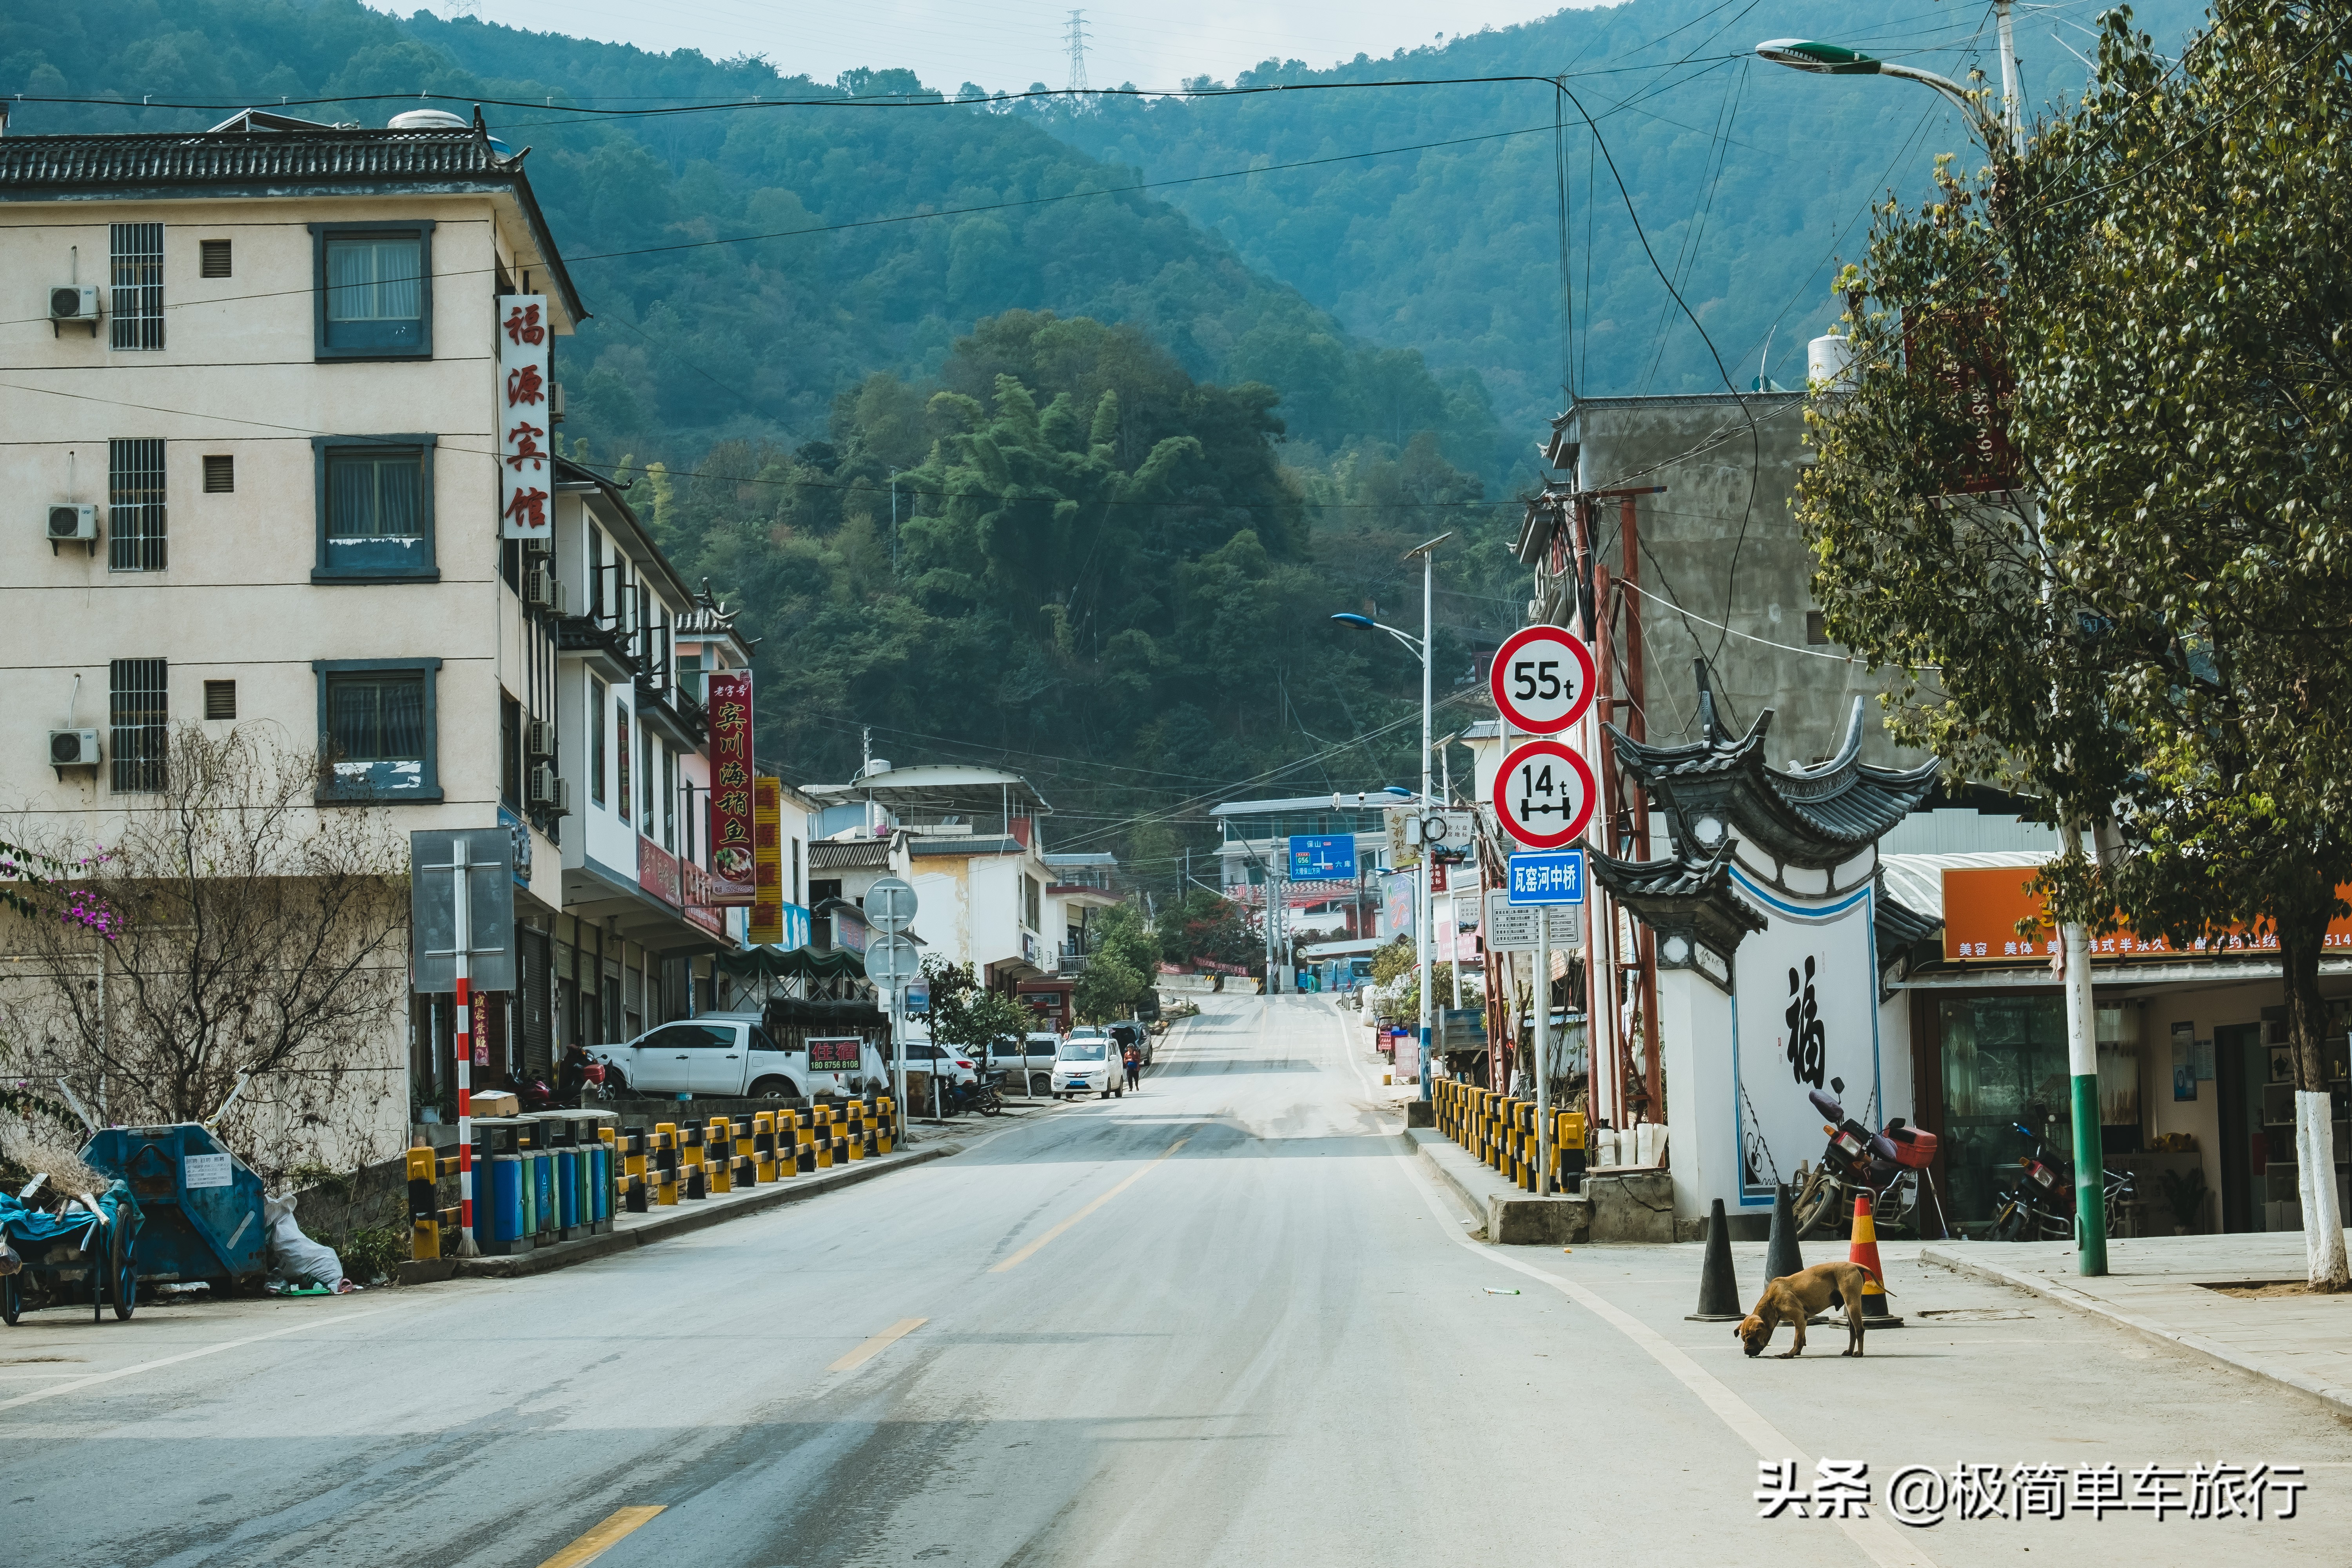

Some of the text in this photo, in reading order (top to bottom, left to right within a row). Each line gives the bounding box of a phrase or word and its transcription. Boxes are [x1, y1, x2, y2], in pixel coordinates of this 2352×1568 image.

[503, 303, 548, 529] 福源宾馆
[714, 684, 749, 697] 老字号
[715, 702, 750, 844] 宾川海稍鱼
[1514, 864, 1576, 892] 瓦窑河中桥
[1959, 942, 1987, 956] 美容
[2004, 941, 2033, 955] 美体
[2324, 933, 2351, 946] 514
[1786, 955, 1826, 1090] 福
[811, 1042, 858, 1061] 住宿
[811, 1060, 858, 1069] 180 8756 8108
